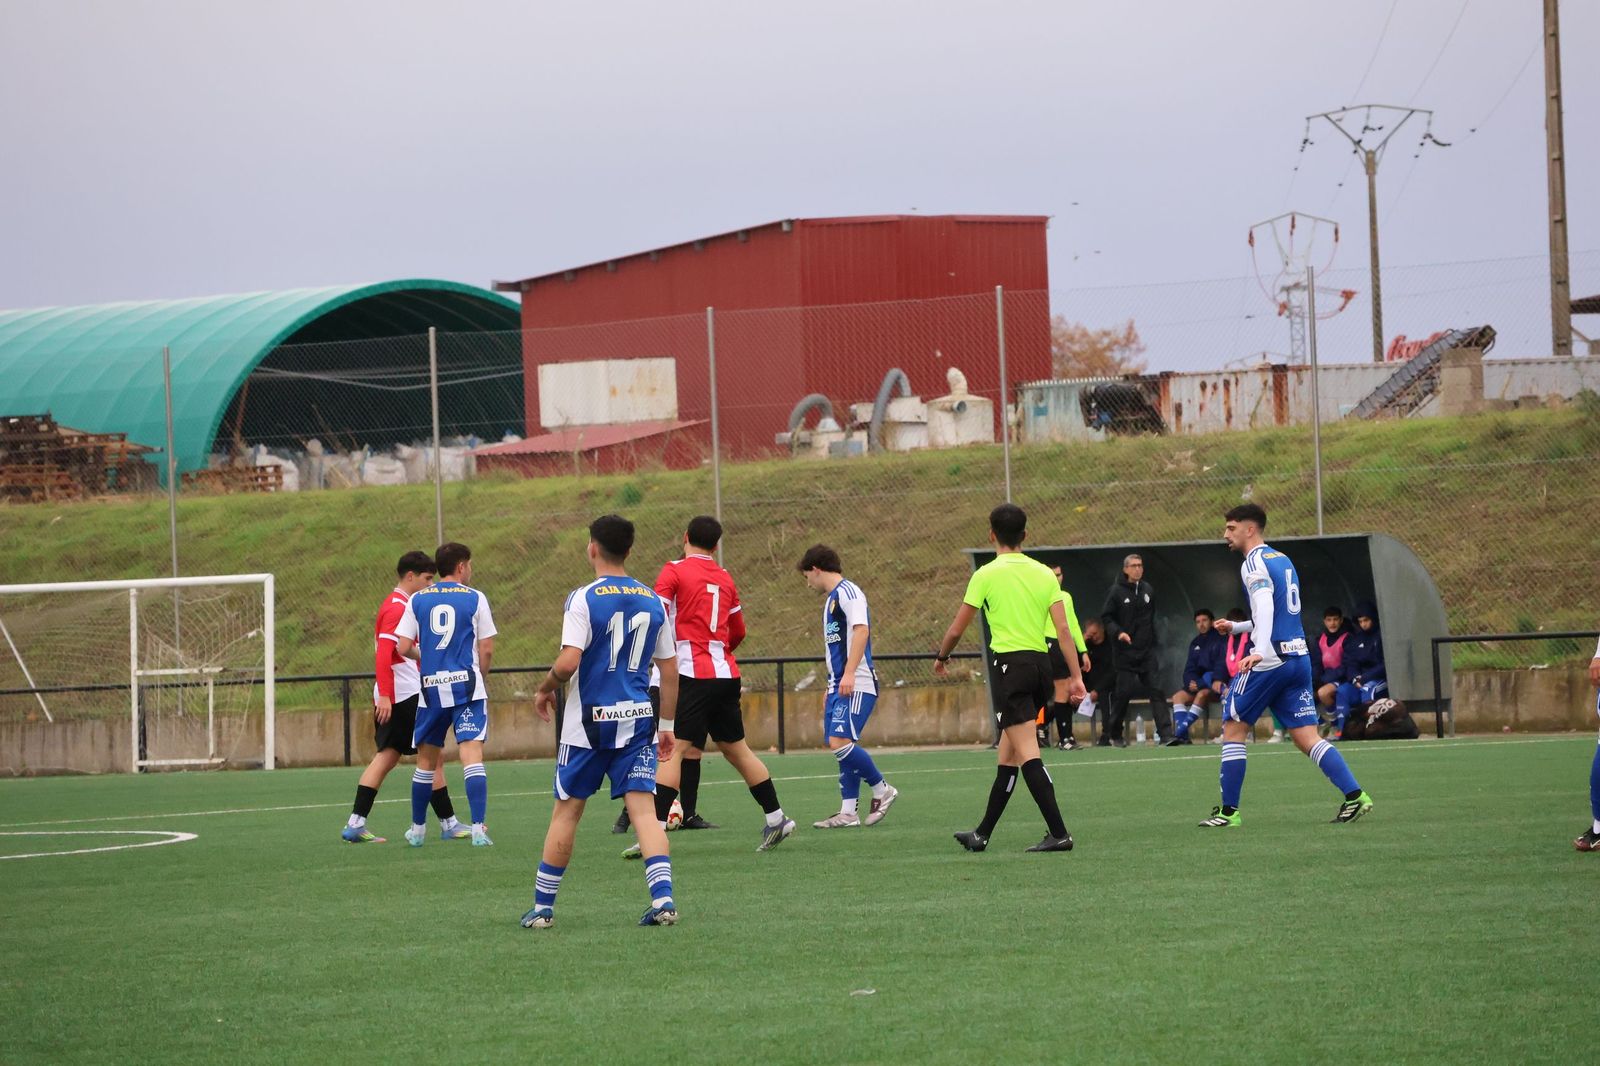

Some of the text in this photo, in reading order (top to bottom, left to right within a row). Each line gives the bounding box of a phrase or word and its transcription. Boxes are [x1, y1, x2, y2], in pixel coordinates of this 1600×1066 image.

[594, 585, 621, 596] CAJA
[1285, 568, 1301, 615] 6
[429, 603, 456, 650] 9
[605, 611, 651, 673] 11
[430, 674, 468, 685] VALCARCE
[606, 707, 653, 720] VALCARCE
